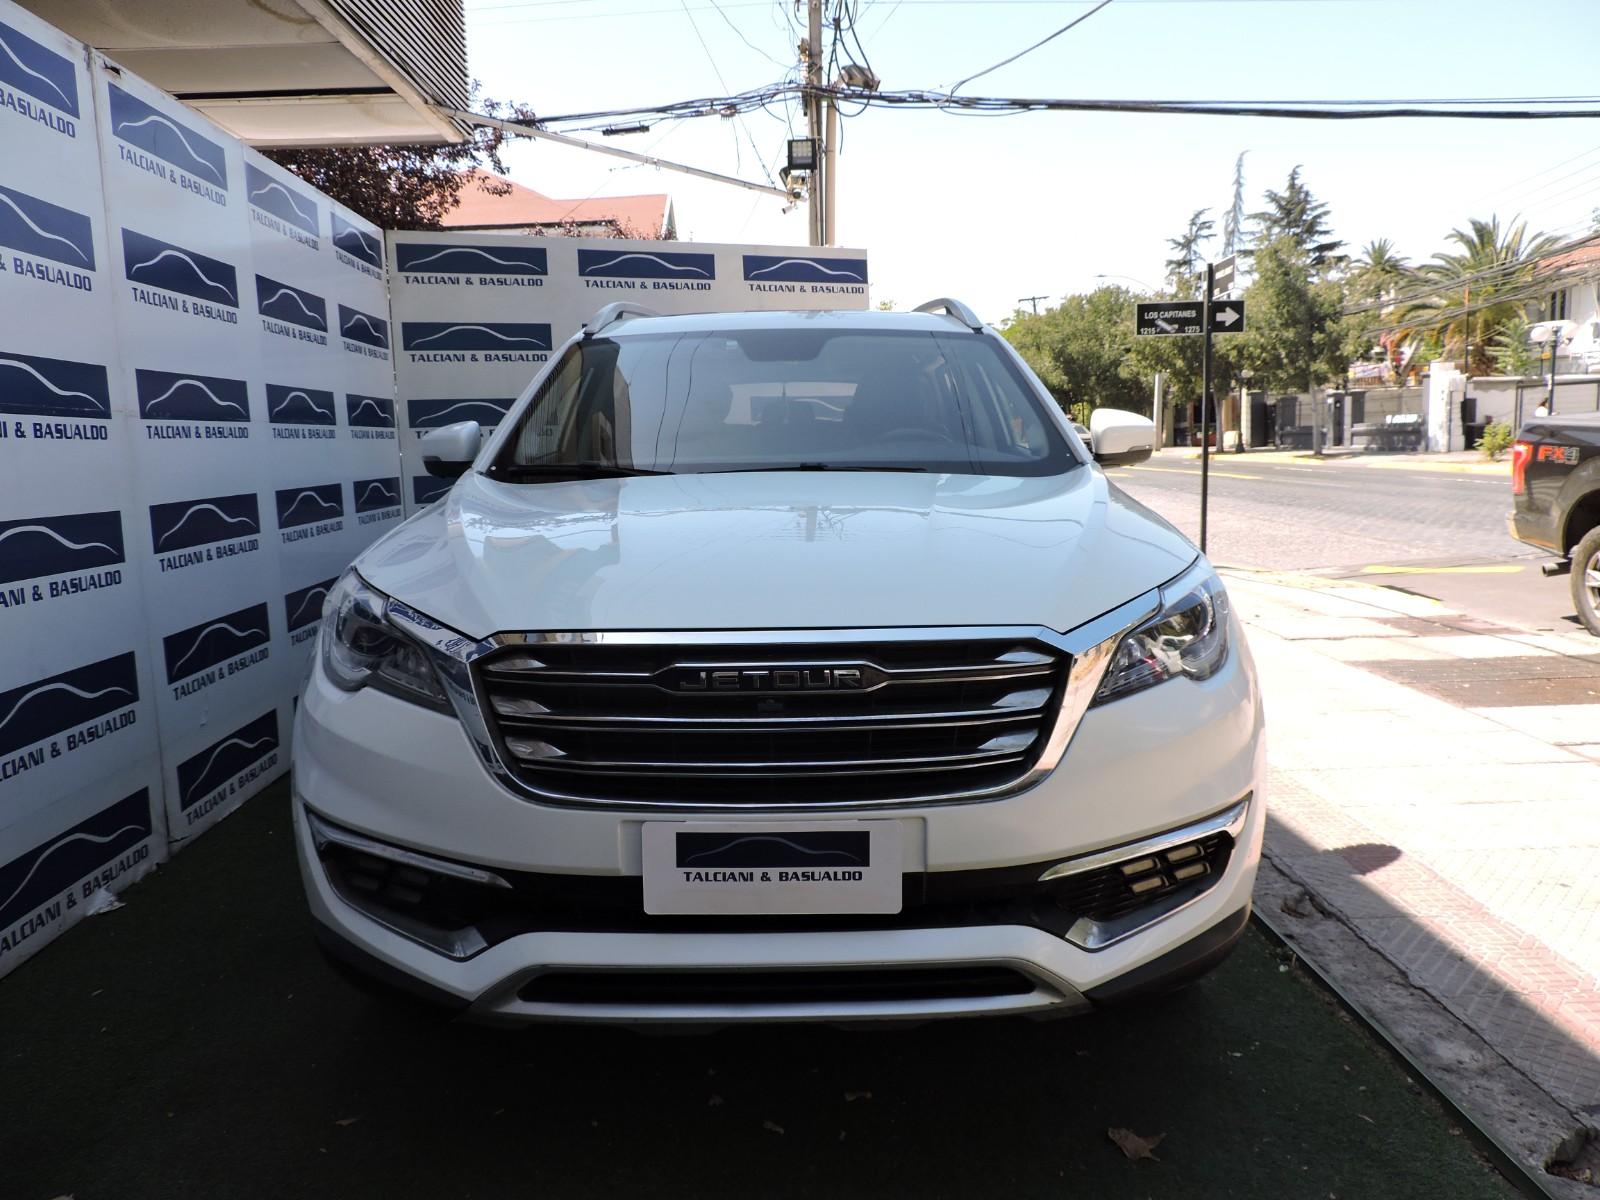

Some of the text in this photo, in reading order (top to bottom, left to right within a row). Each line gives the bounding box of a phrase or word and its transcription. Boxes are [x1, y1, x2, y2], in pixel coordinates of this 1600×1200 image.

[118, 144, 226, 207] TALCIANI & BASUALDO
[13, 256, 92, 292] BASUALDO
[404, 275, 544, 287] TALCIANI & BASUALDO
[584, 279, 711, 291] TALCIANI & BASUALDO
[749, 283, 864, 295] TALCIANI & BASUALDO
[132, 287, 237, 324] TALCIANI & BASUALDO
[1144, 309, 1197, 320] LOS CAPITANES
[1140, 327, 1156, 335] 1215
[1184, 326, 1200, 334] 1275
[409, 353, 548, 363] TALCIANI & BASUALDO
[14, 421, 26, 438] &
[32, 422, 108, 440] BASUALDO
[146, 425, 249, 439] TALCIANI & BASUALDO
[159, 538, 259, 573] TALCIANI & BASUALDO
[32, 585, 43, 602] &
[49, 569, 122, 599] BASUALDO
[172, 647, 269, 701] TALCIANI & BASUALDO
[679, 669, 861, 689] JETOUR
[51, 742, 61, 758] &
[67, 709, 136, 752] BASUALDO
[186, 753, 278, 826] TALCIANI & BASUALDO
[684, 871, 863, 882] TALCIANI & BASUALDO
[0, 844, 149, 957] ALCIANI & BASUALDO
